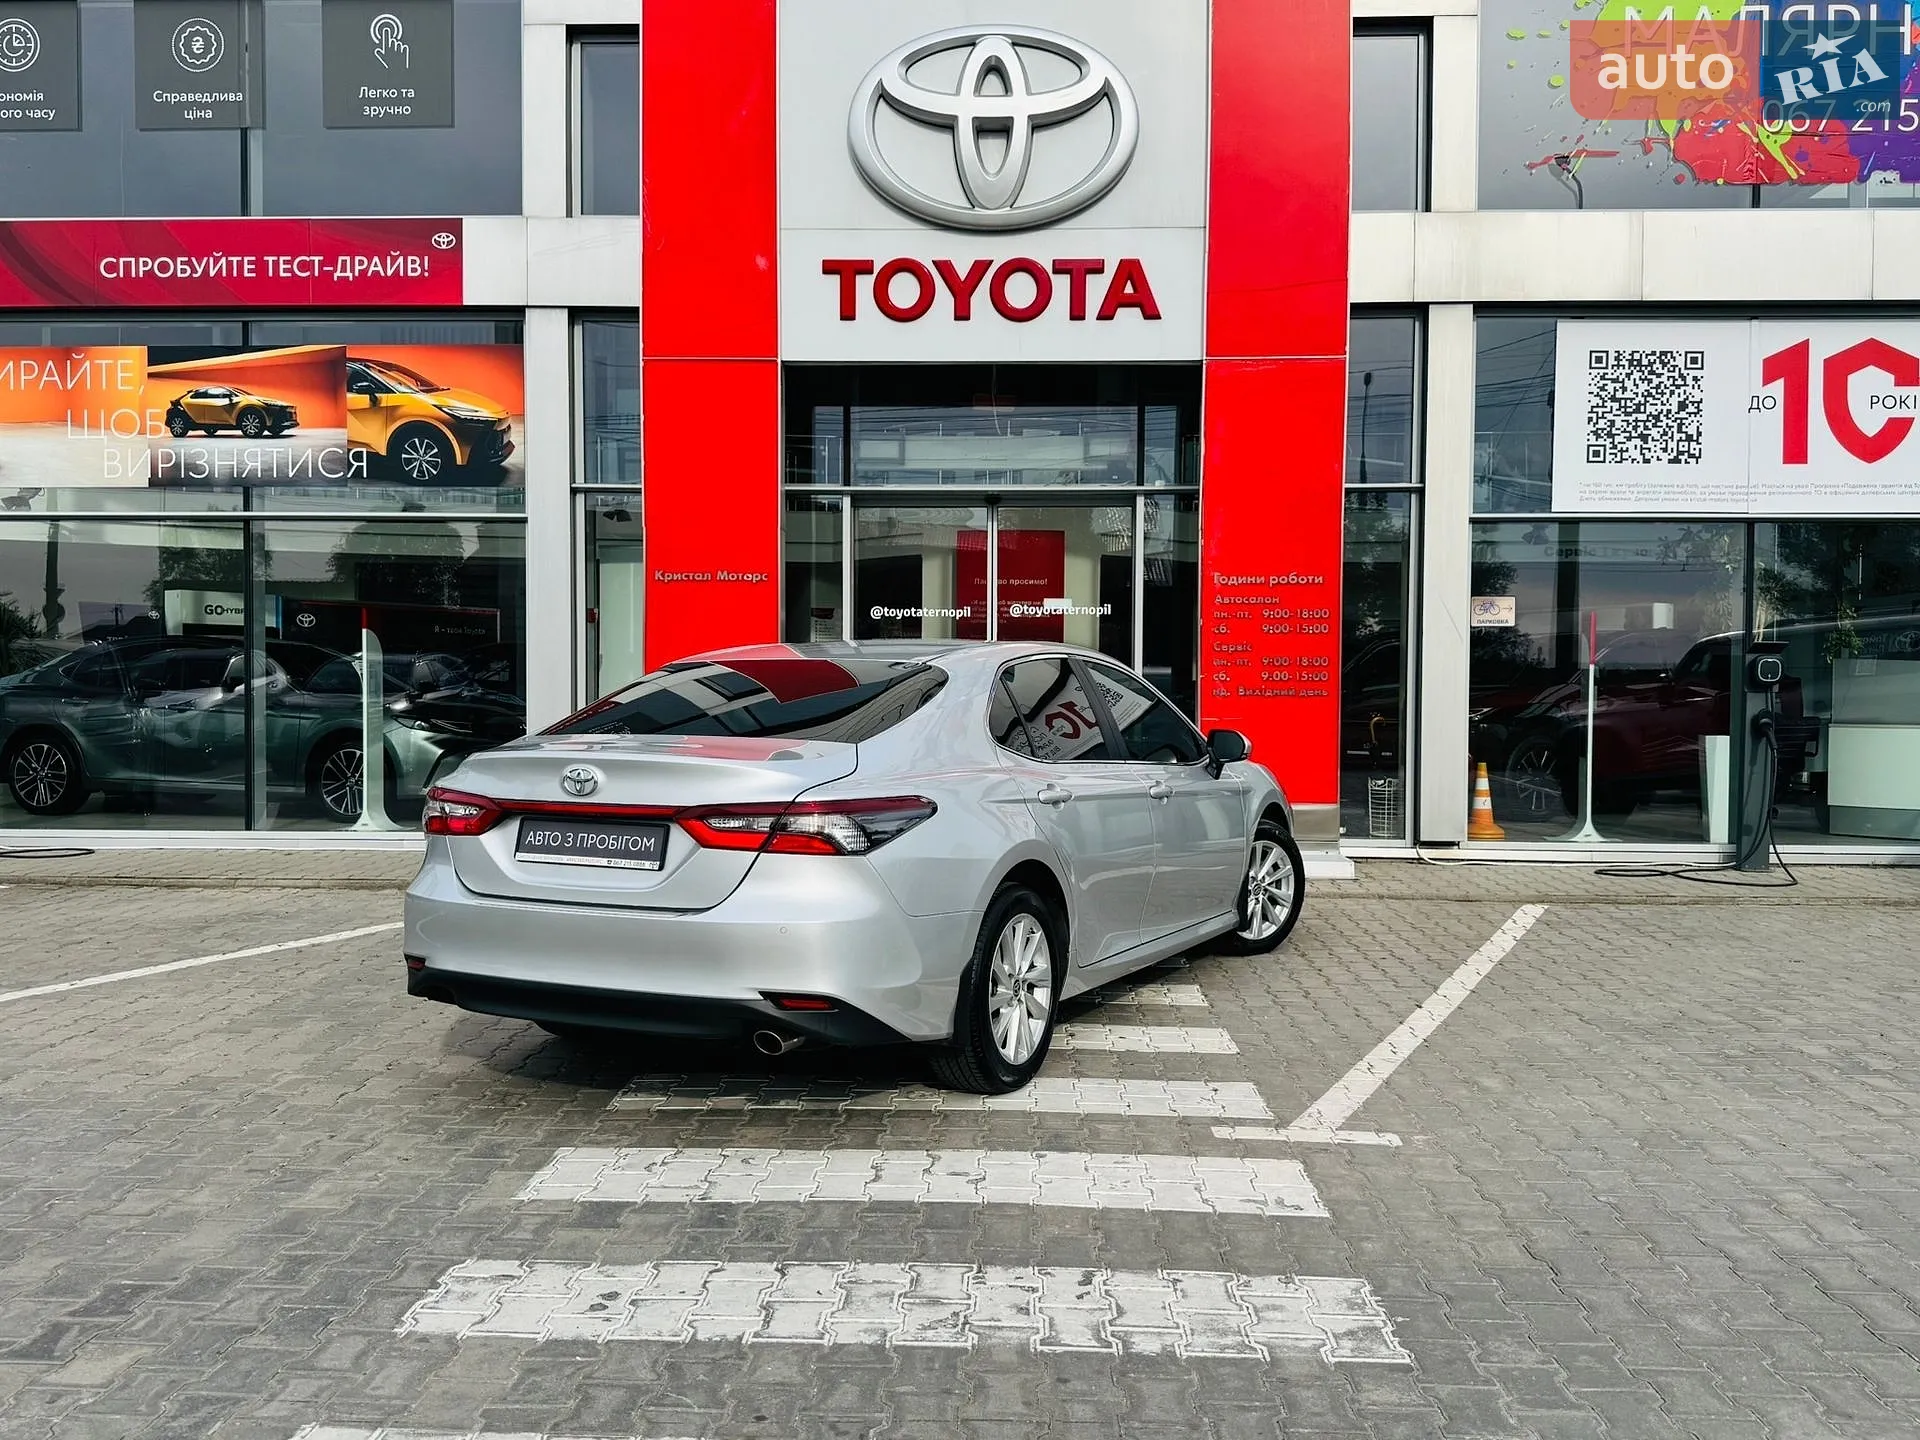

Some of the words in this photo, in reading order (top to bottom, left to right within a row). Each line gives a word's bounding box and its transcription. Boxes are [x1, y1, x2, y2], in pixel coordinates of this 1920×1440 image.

[0, 90, 44, 102] ономія
[153, 90, 243, 104] Справедлива
[358, 86, 398, 98] Легко
[400, 88, 415, 98] та
[0, 109, 23, 119] ого
[25, 109, 56, 121] часу
[184, 106, 213, 120] ціна
[363, 105, 412, 118] зручно
[1762, 98, 1837, 133] 067
[99, 251, 257, 279] СПРОБУЙТЕ
[263, 250, 430, 281] ТЕСТ-ДРАЙВ!
[821, 256, 1163, 323] TOYOTA
[0, 352, 145, 396] ИРАЙТЕ,
[1748, 394, 1778, 414] ДО
[1869, 394, 1918, 410] РОКІ
[66, 407, 167, 445] ЩОБ
[103, 447, 369, 480] ВИРІЗНЯТИСЯ
[654, 569, 712, 583] Кристал
[716, 570, 769, 584] Моторс
[1009, 577, 1049, 587] просимо!
[1212, 571, 1266, 587] Години
[1269, 571, 1324, 587] роботи
[1214, 594, 1281, 605] Автосалон
[870, 605, 972, 620] @toyotaternopil
[1009, 603, 1112, 618] @toyotaternopil
[1213, 623, 1231, 634] сб.
[1212, 640, 1253, 653] Сервіс
[1212, 670, 1231, 681] сб.
[1237, 684, 1296, 697] Вихідний
[1299, 689, 1329, 697] день
[525, 829, 562, 847] АВТО
[576, 833, 656, 853] ПРОБІГОМ
